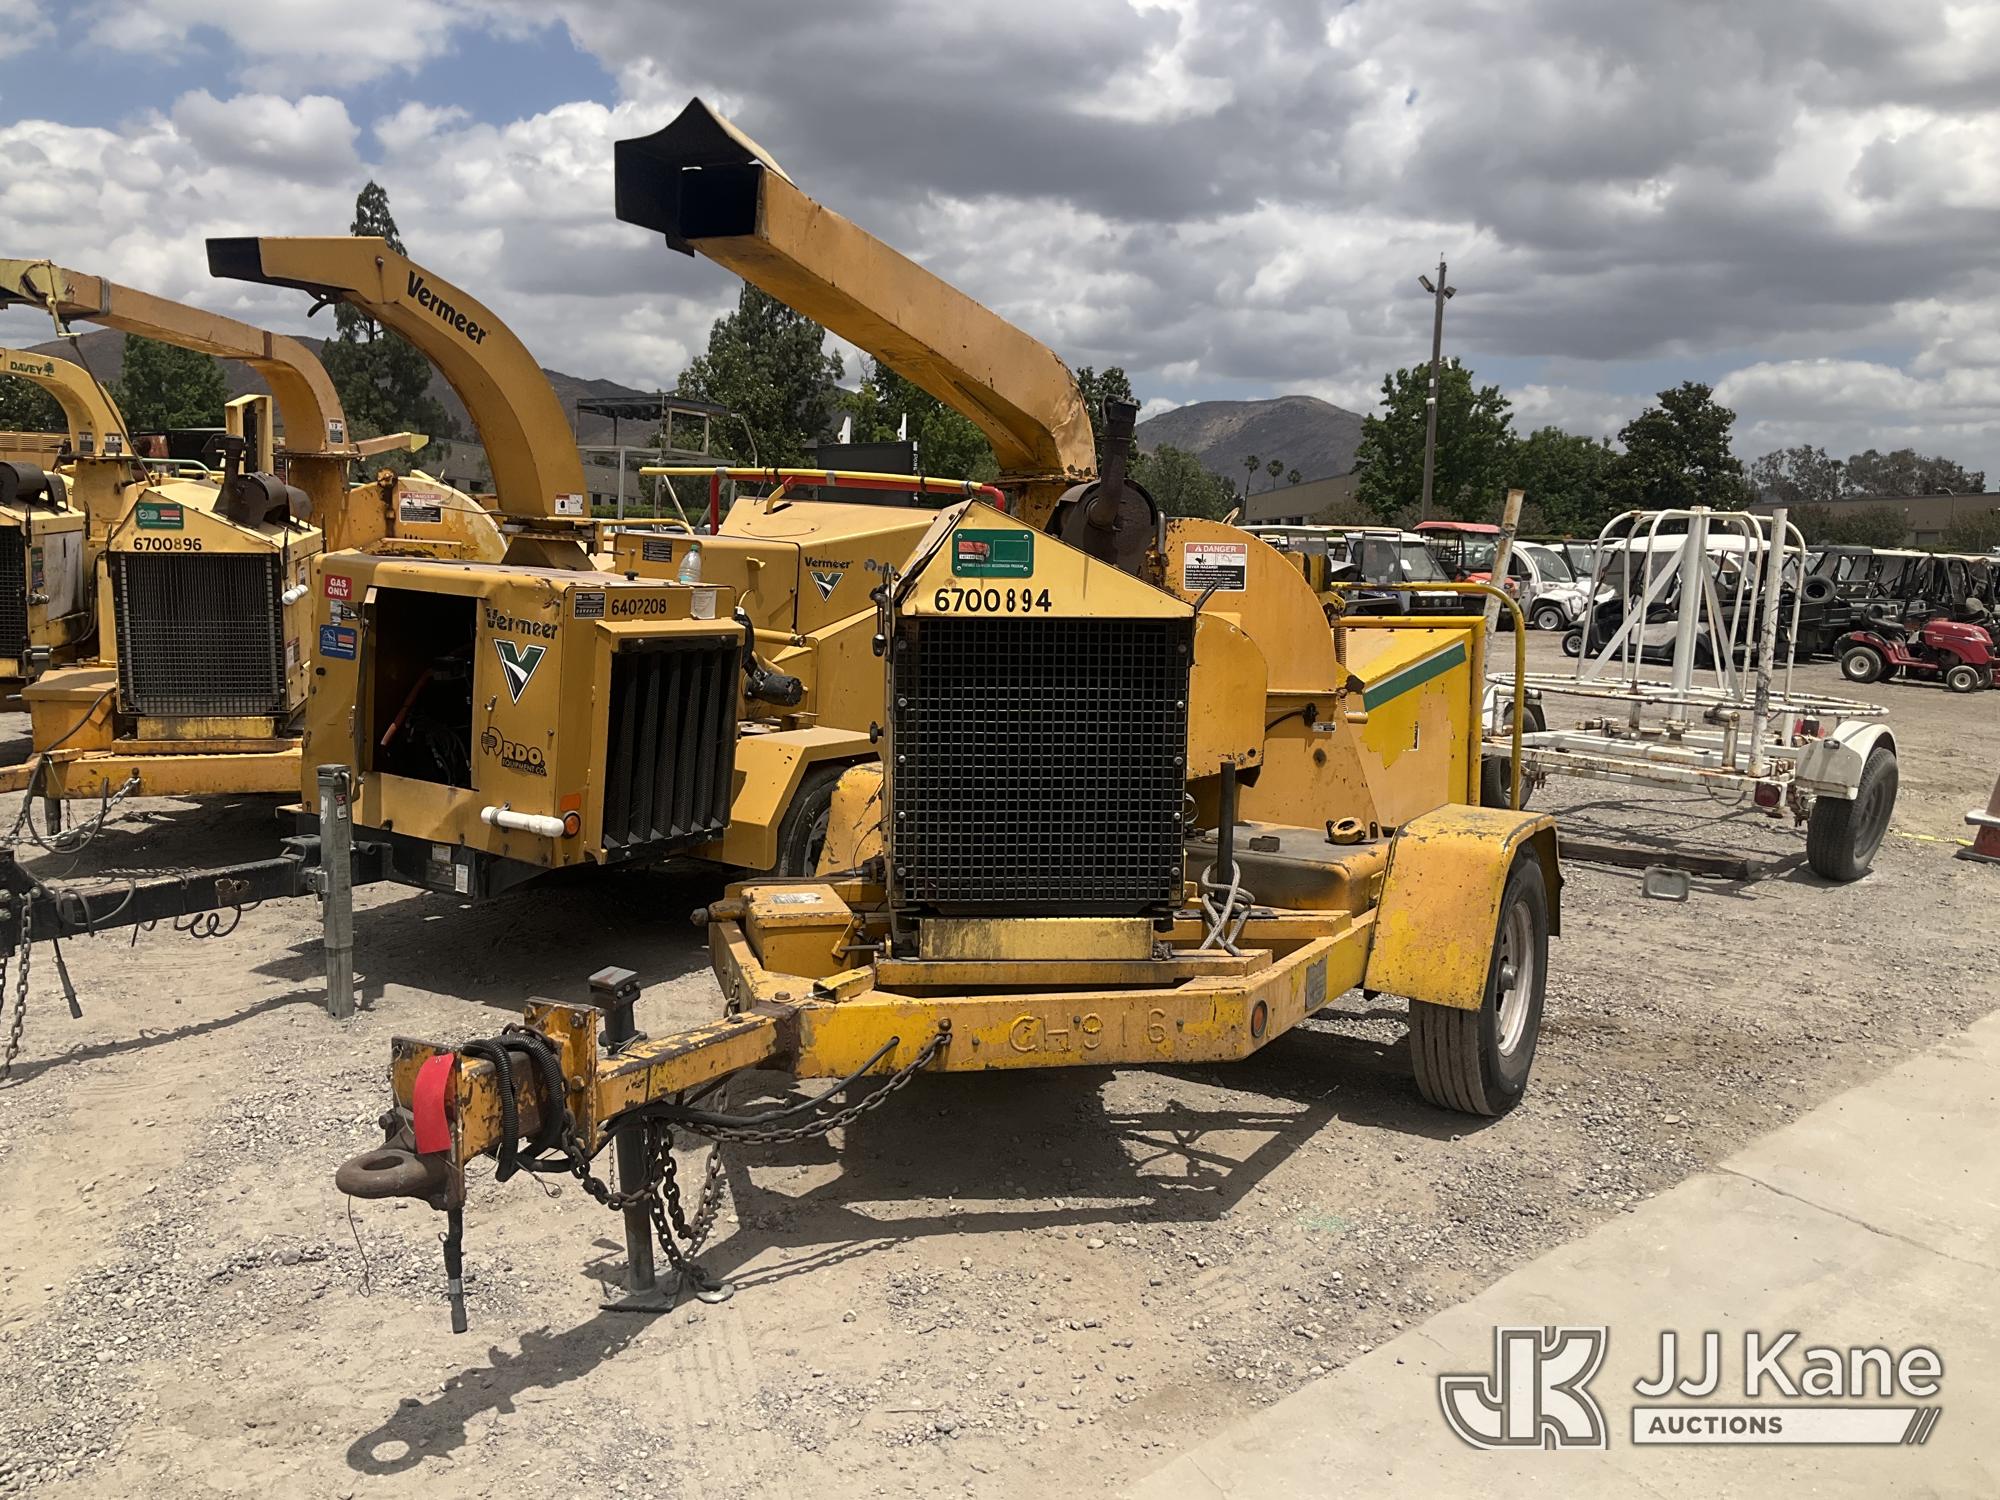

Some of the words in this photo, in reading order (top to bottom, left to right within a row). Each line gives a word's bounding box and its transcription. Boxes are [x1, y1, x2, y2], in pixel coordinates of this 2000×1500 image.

[407, 270, 486, 345] Vermeer
[10, 361, 43, 375] DAVEY
[133, 537, 202, 551] 6700896
[1203, 545, 1236, 553] DANGER
[804, 557, 850, 569] Vermeer
[330, 577, 347, 588] GAS
[327, 586, 349, 597] ONLY
[934, 588, 1052, 613] 6700894
[485, 607, 558, 640] Vermeer
[1009, 1008, 1167, 1052] CH916
